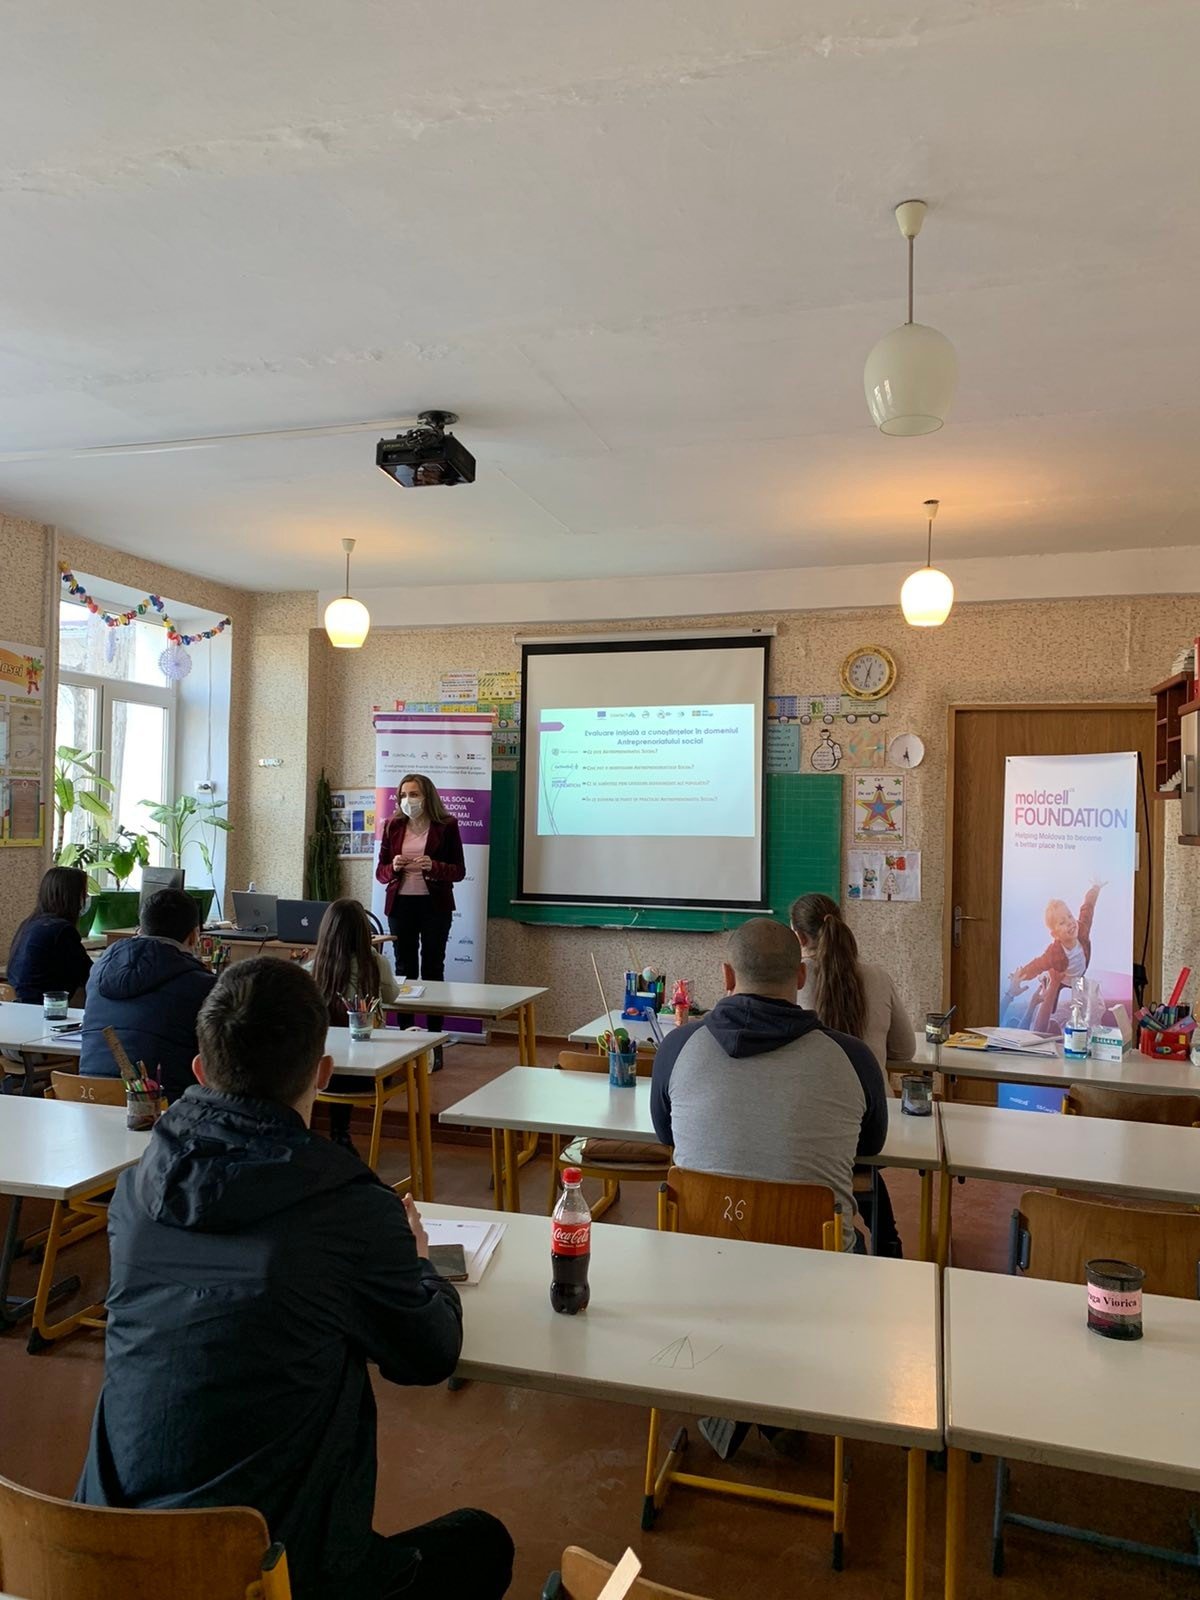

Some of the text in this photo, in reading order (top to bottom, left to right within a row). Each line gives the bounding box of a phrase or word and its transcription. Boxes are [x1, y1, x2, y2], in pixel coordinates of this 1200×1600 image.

[703, 727, 739, 735] domeniul
[617, 737, 704, 746] Antreprenoriatului social
[1015, 789, 1069, 806] moldcell
[1014, 807, 1128, 829] FOUNDATION
[1015, 832, 1038, 841] Helping
[1039, 833, 1066, 841] Moldova
[1074, 834, 1103, 842] become
[1020, 841, 1038, 849] better
[1038, 842, 1055, 850] place
[80, 1085, 95, 1100] 26
[723, 1195, 747, 1222] 26
[1102, 1296, 1138, 1308] Viorica
